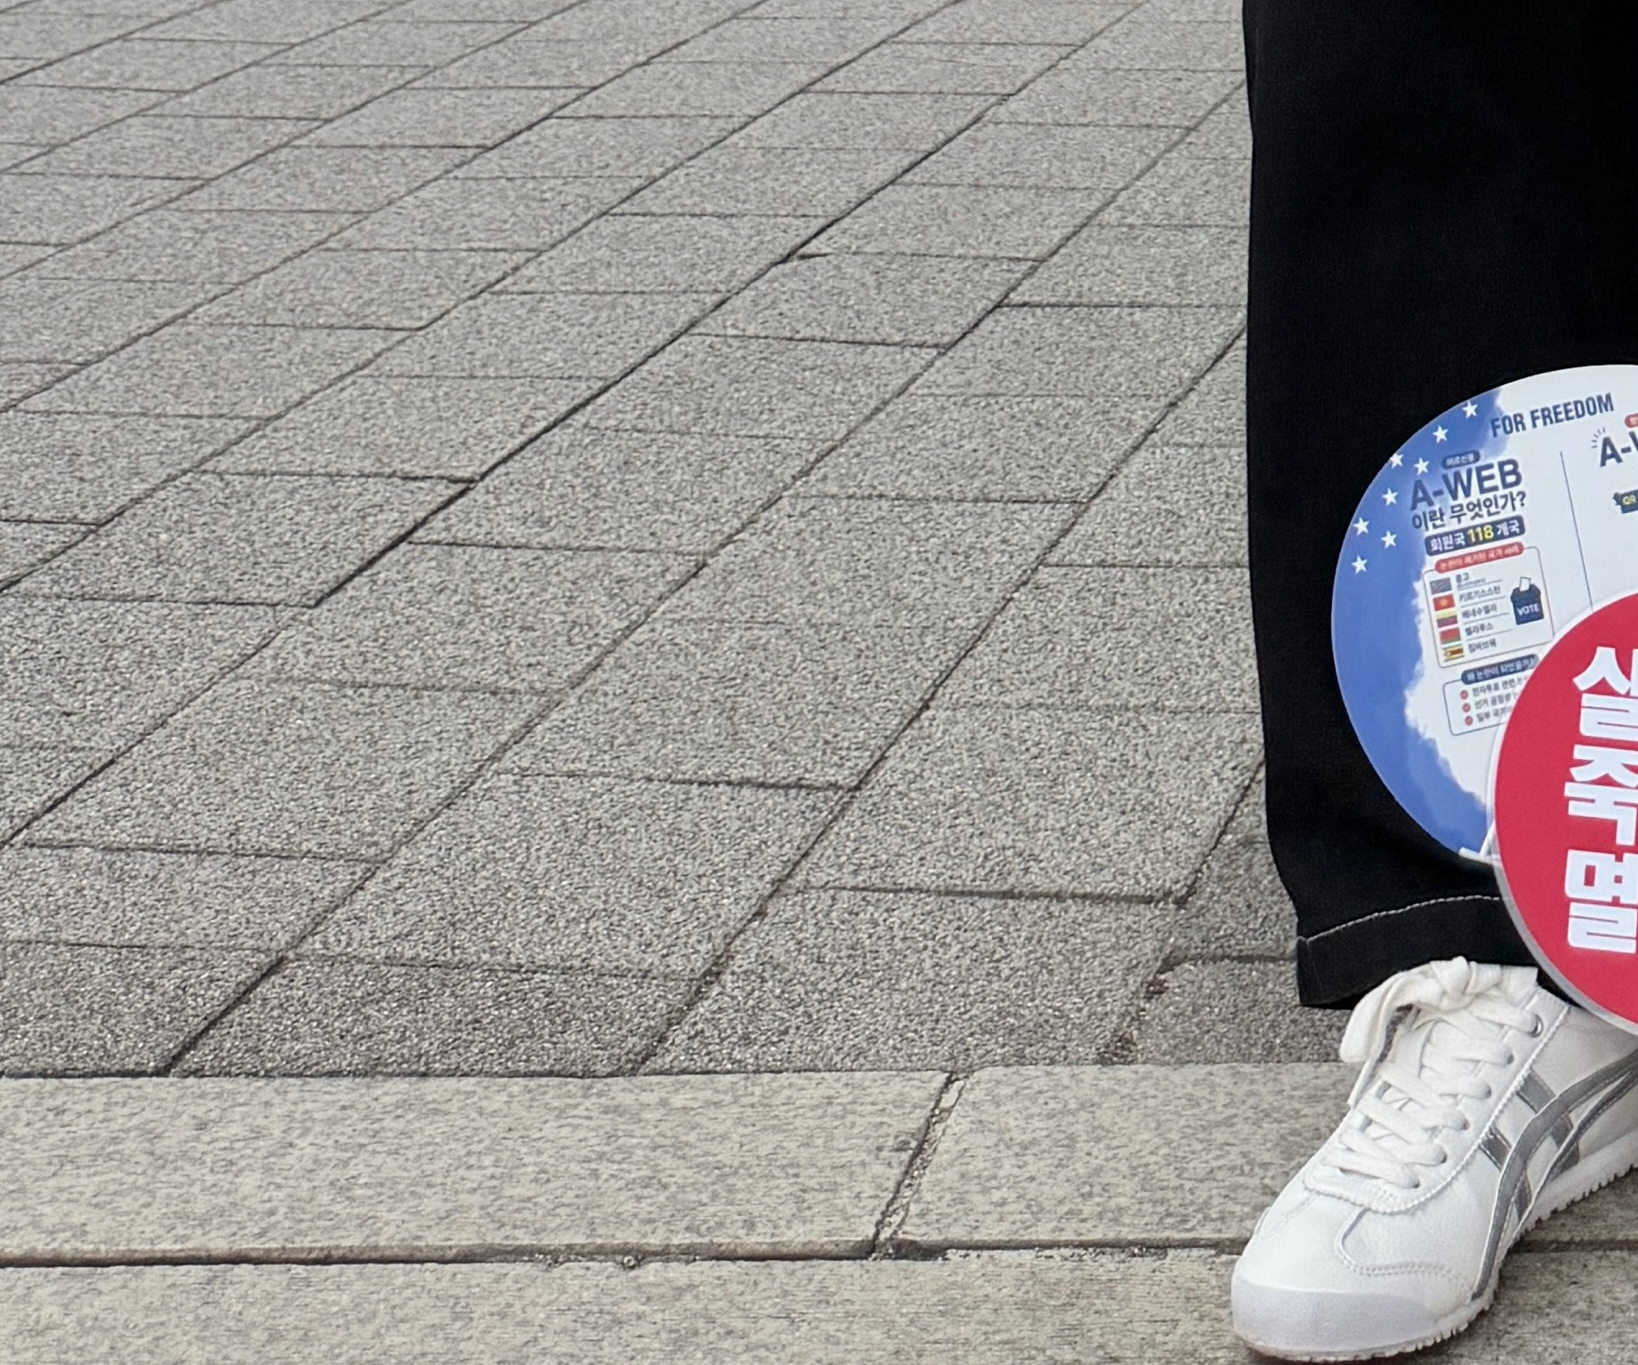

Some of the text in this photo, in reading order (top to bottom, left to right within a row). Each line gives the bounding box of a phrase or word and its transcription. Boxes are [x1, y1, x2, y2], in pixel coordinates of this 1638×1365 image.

[1491, 392, 1614, 437] FOR FREEDOM
[1410, 458, 1522, 511] A-WEB
[1412, 491, 1526, 531] 이란 무엇인가?
[1430, 519, 1520, 551] 회원국 118 개국
[1517, 602, 1540, 617] VOTE
